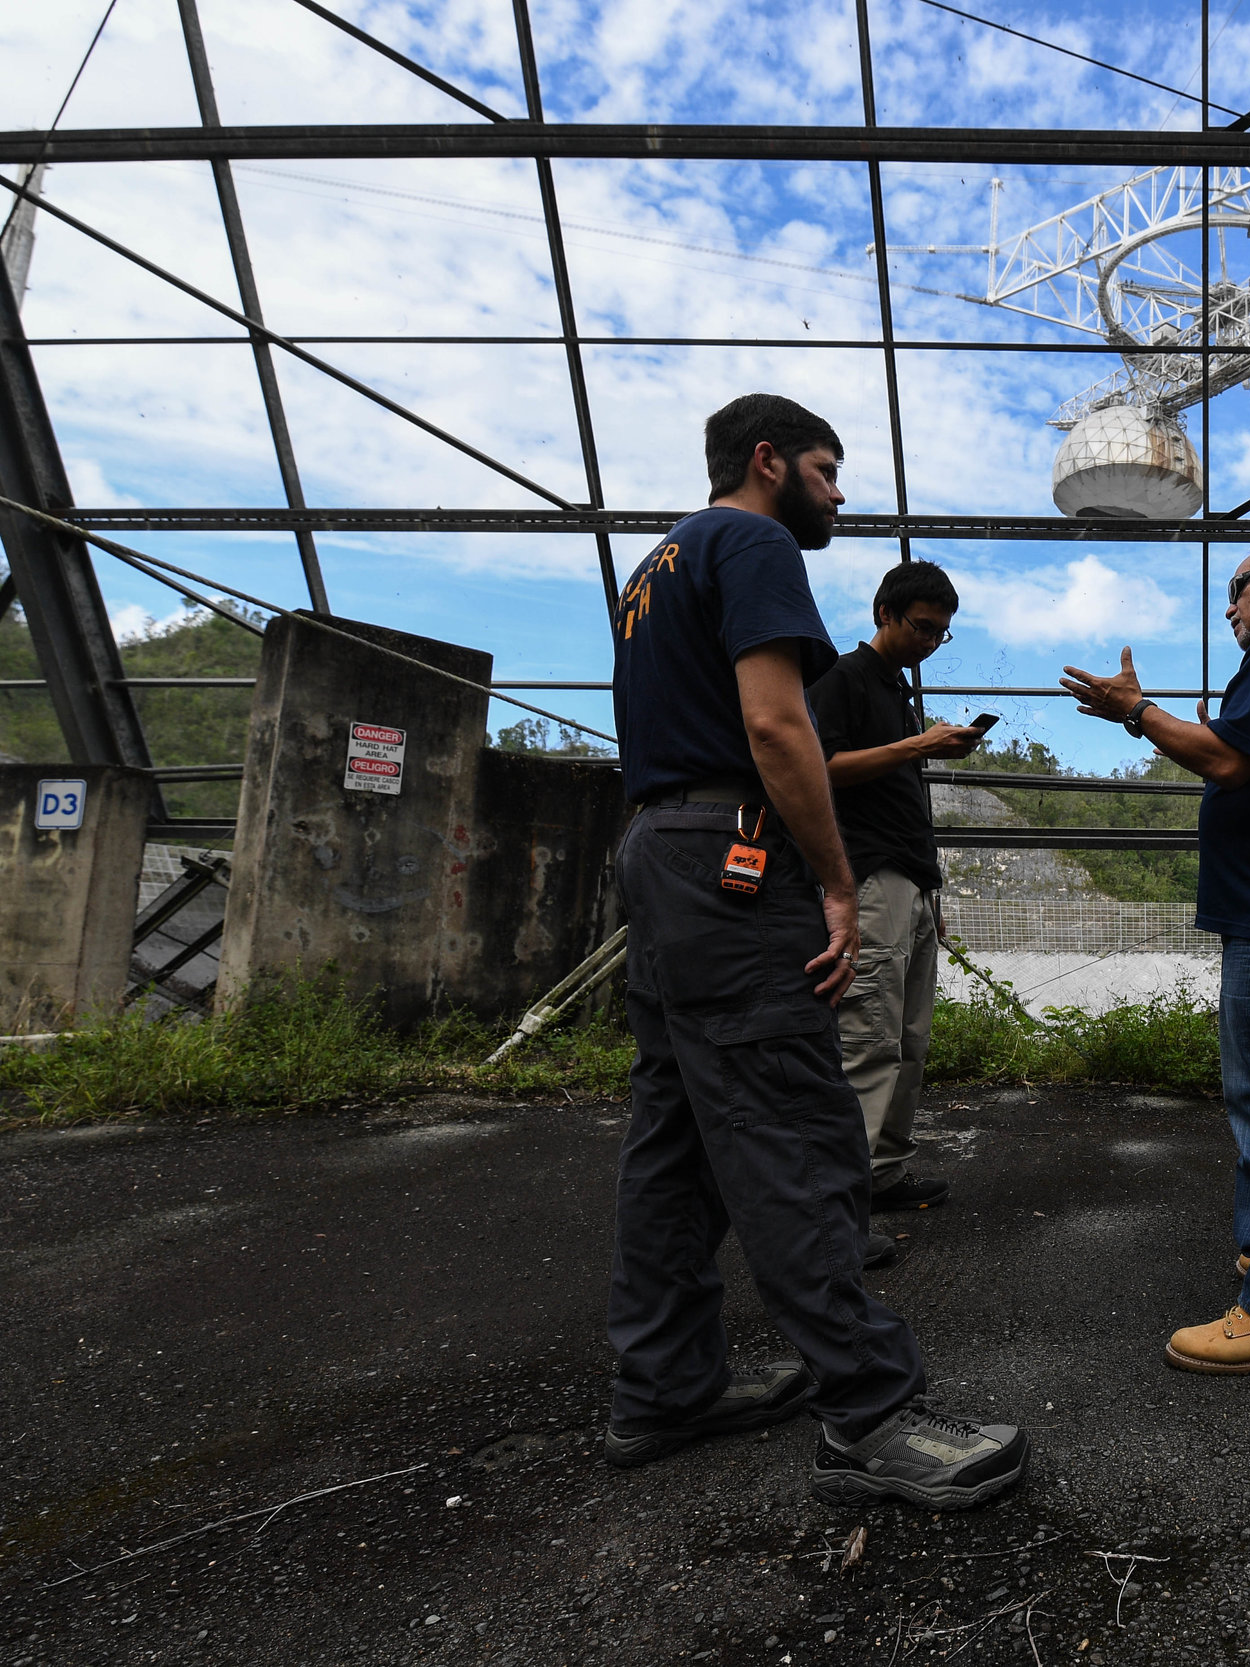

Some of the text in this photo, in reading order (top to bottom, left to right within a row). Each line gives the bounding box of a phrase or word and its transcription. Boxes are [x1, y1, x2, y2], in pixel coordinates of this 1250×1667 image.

[357, 728, 399, 742] DANGER
[355, 741, 399, 753] HARD HAT
[365, 750, 388, 759] AREA
[354, 761, 395, 774] PELIGRO
[382, 777, 400, 785] CASCO
[42, 793, 77, 815] D3
